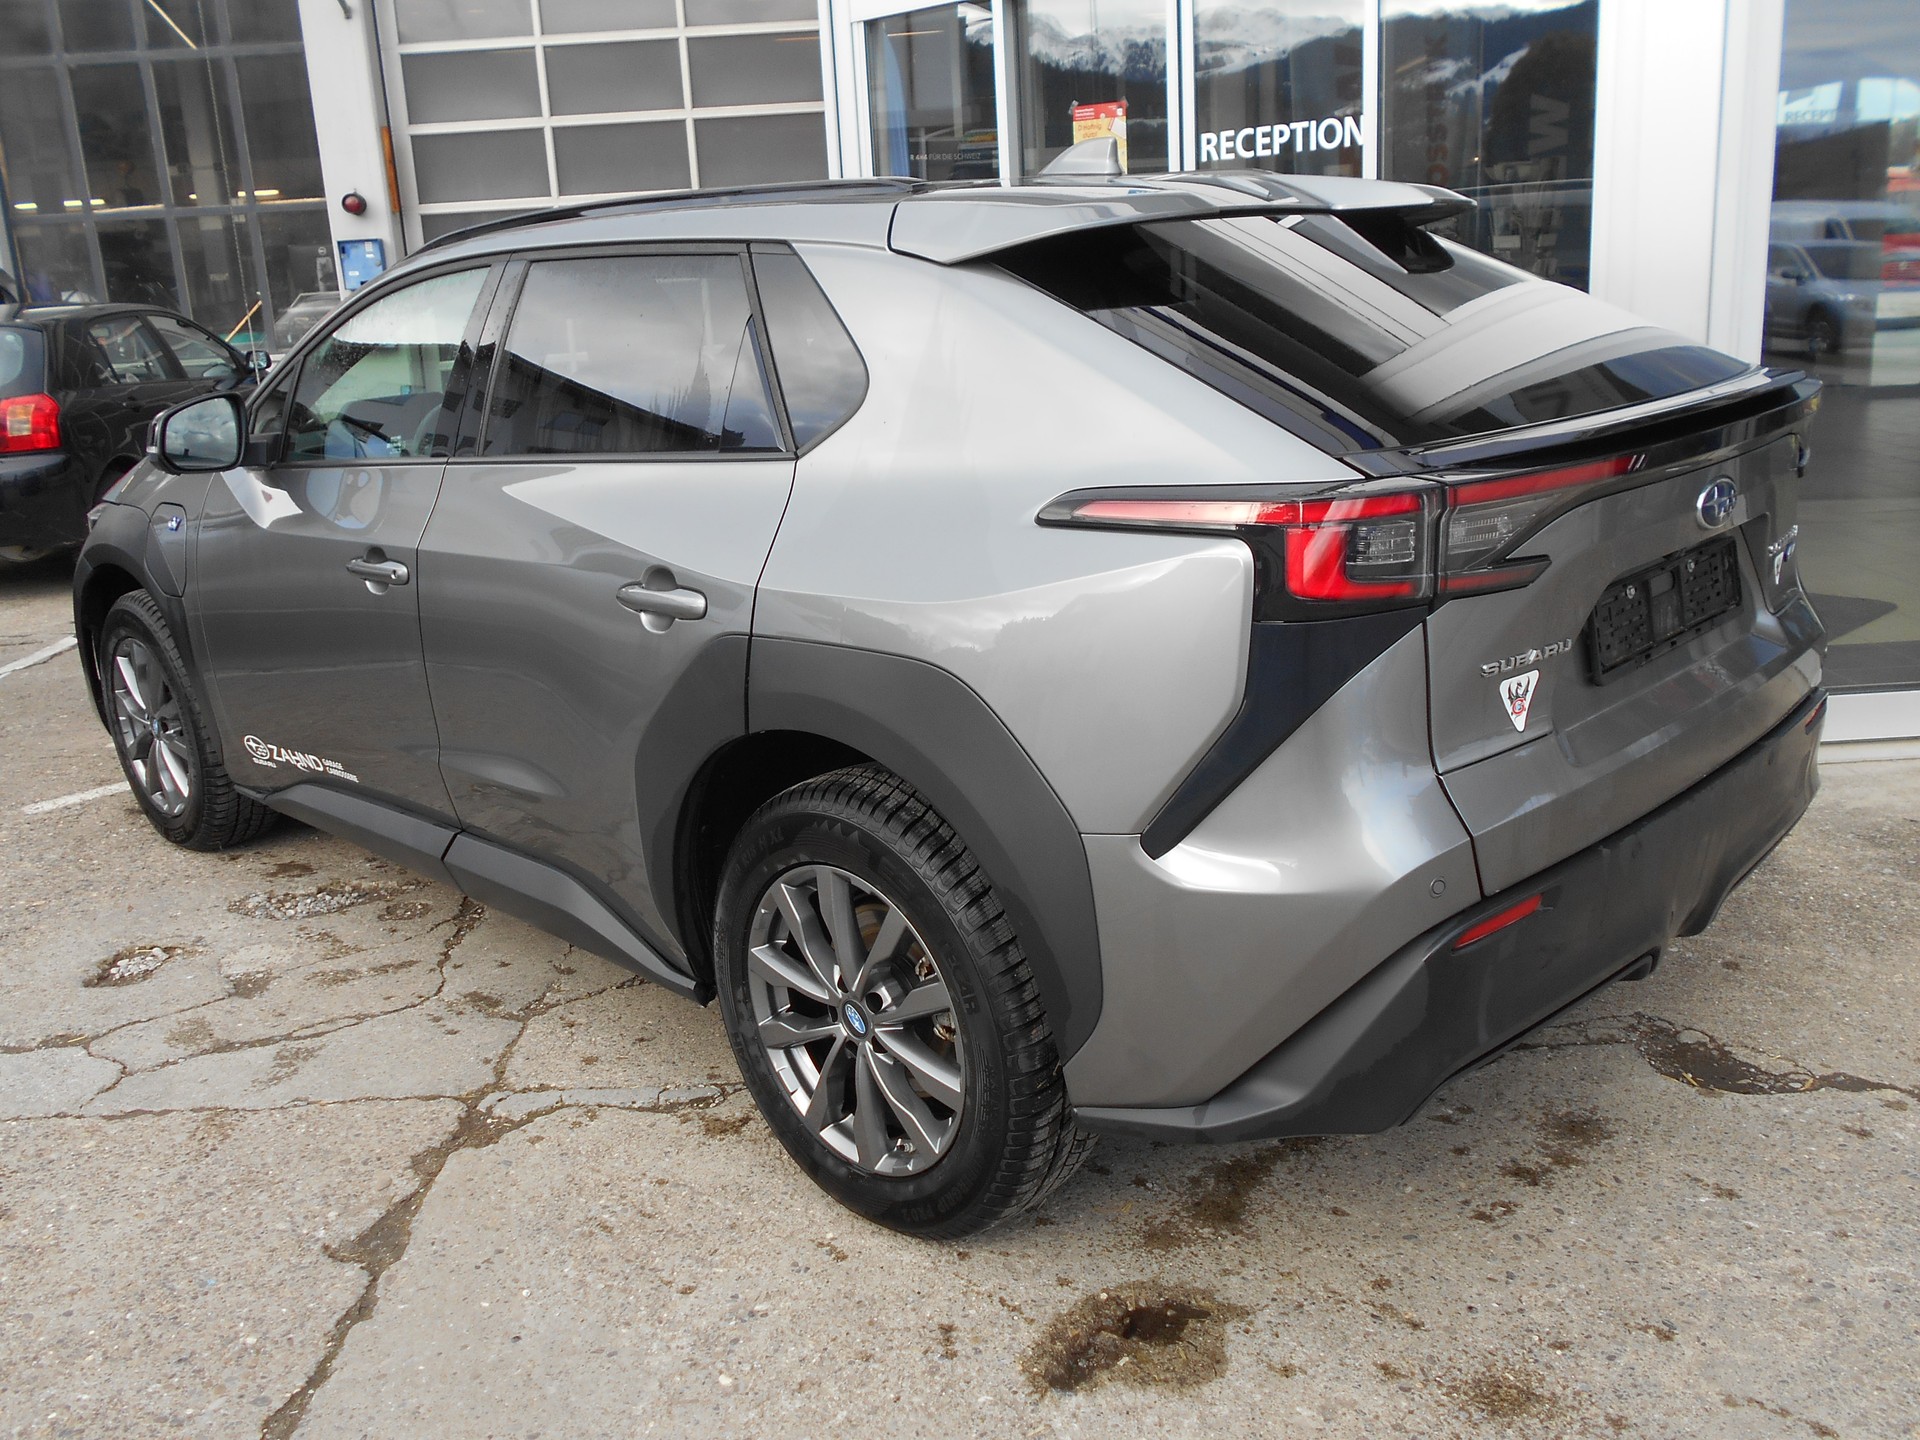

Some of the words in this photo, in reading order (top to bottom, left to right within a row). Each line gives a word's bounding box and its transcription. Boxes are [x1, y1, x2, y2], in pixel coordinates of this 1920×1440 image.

[1200, 115, 1364, 162] RECEPTION
[943, 152, 953, 160] DIE
[954, 152, 981, 160] SCHWEIZ
[1480, 638, 1572, 677] SUBARU
[267, 744, 324, 772] ZAHND
